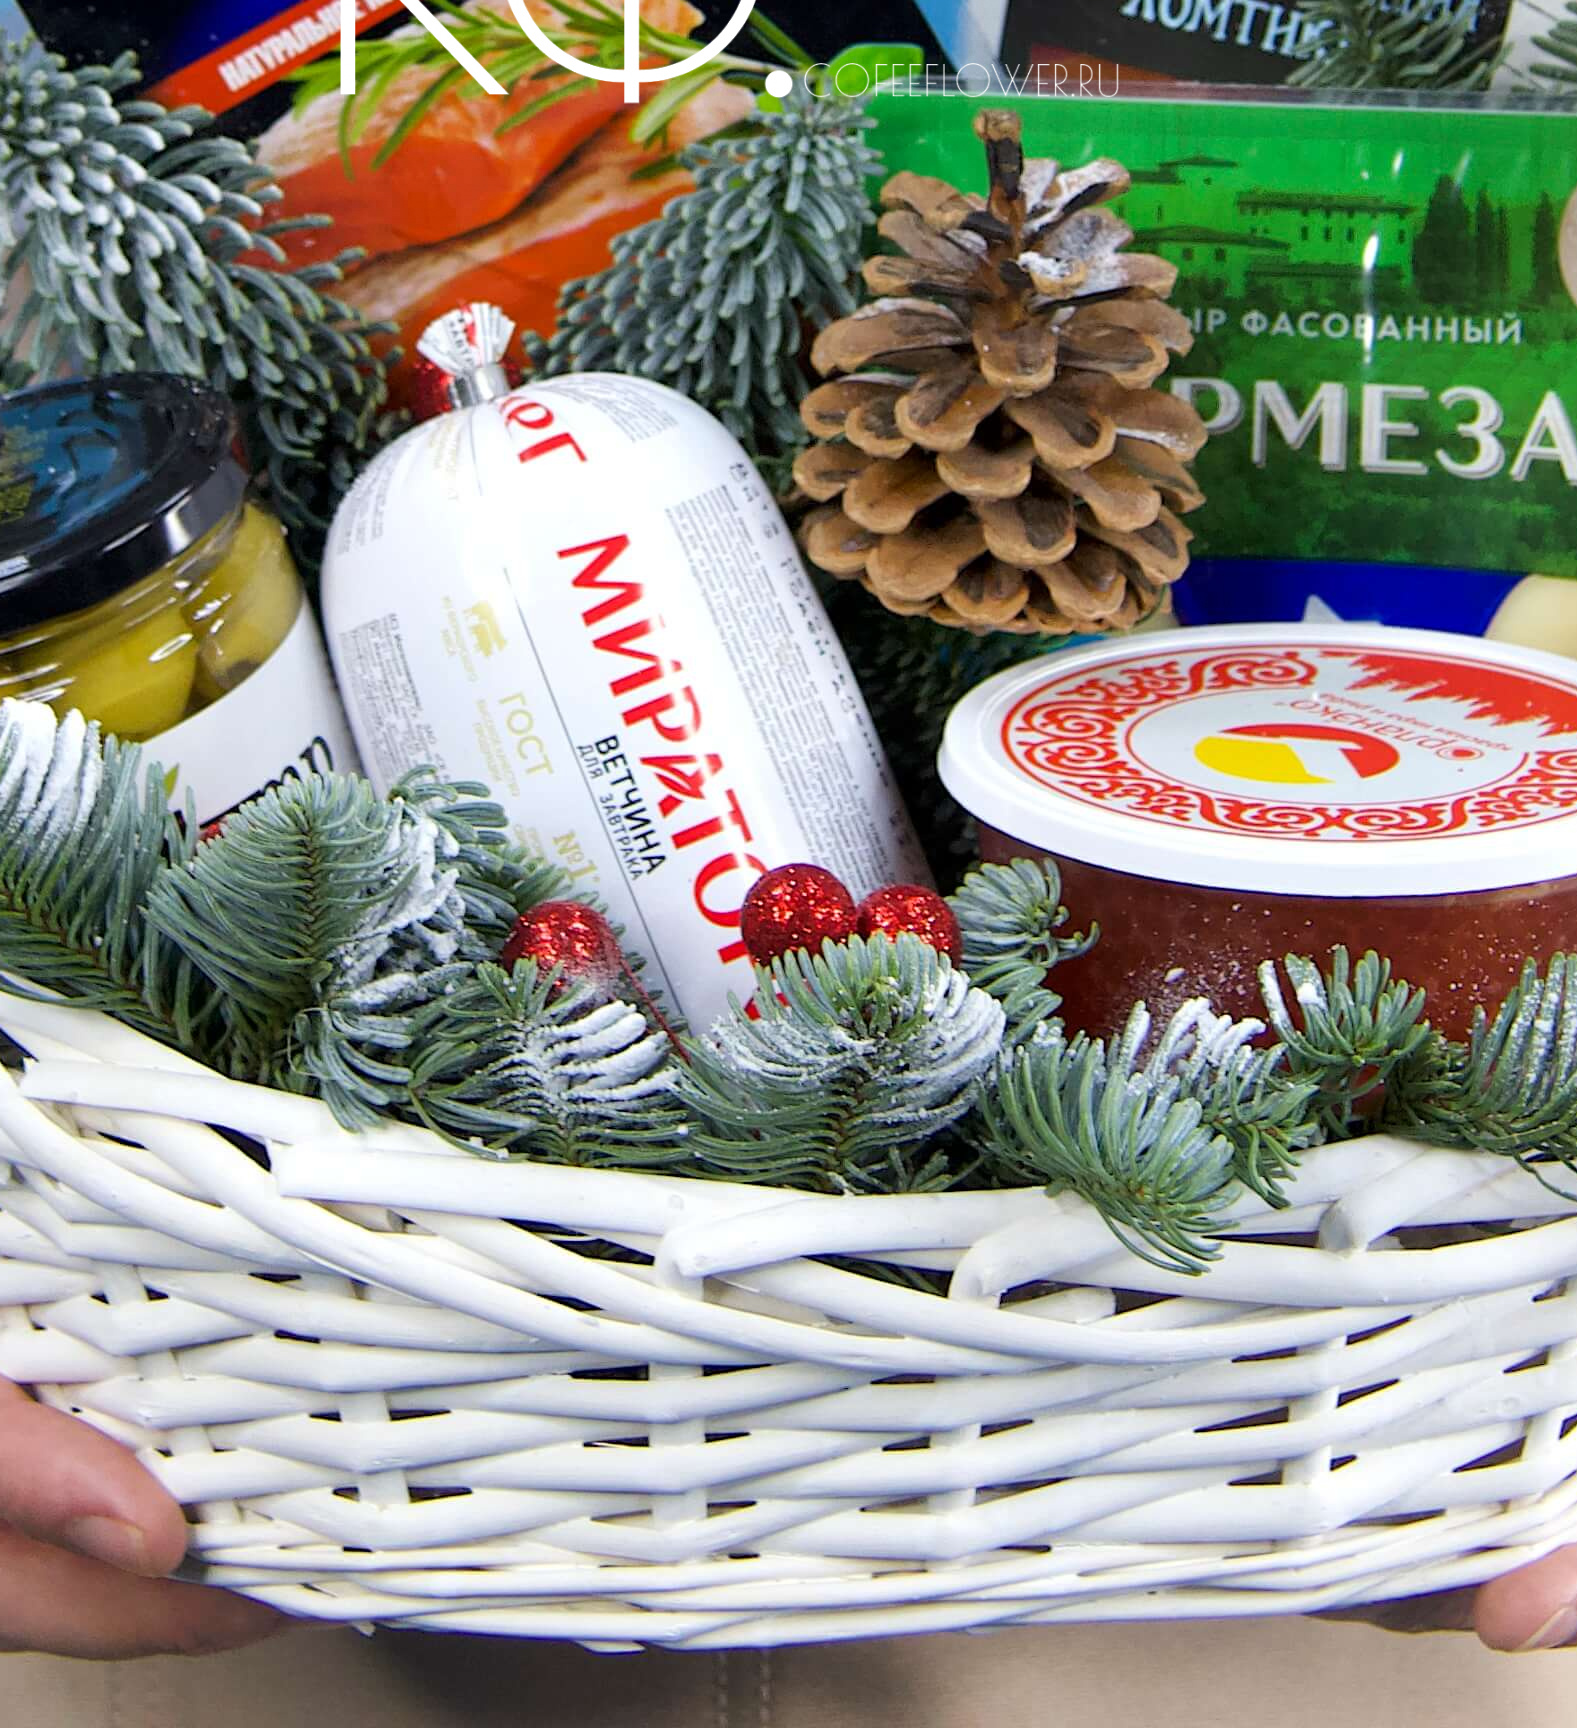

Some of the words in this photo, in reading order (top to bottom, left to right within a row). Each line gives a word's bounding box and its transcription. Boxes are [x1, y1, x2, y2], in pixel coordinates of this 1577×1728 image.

[1241, 309, 1522, 345] ФАСОВАННЫЙ
[498, 691, 554, 776] ГОСТ
[557, 533, 790, 1020] МИРАТО
[577, 744, 602, 780] ДЛЯ
[600, 795, 645, 881] ЗАВТРАКА
[594, 735, 666, 876] ВЕТЧИНА
